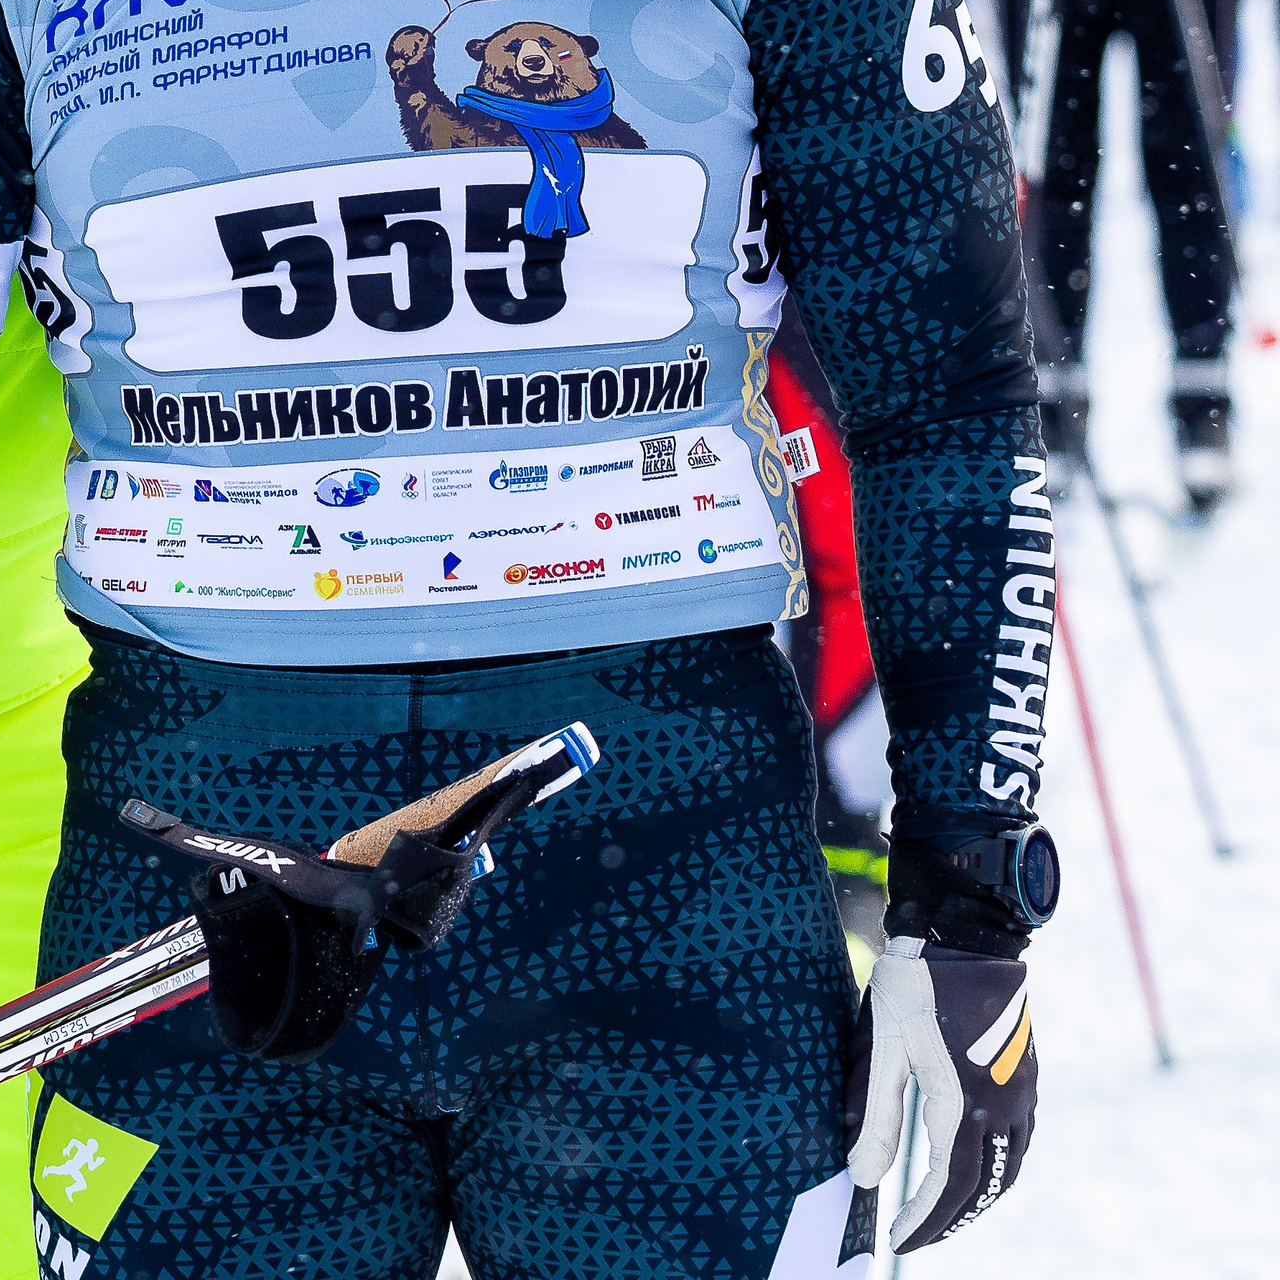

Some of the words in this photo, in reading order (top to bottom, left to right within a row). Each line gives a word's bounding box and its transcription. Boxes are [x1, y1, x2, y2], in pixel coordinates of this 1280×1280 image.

[152, 25, 289, 66] МАРАФОН
[99, 80, 142, 106] И.П.
[152, 41, 372, 90] ФАРХУТДИНОВА
[214, 182, 569, 340] 555
[122, 379, 431, 445] Мельников
[445, 346, 708, 428] Анатолий
[578, 459, 634, 477] ГАЗПРОМБАНК
[645, 458, 673, 473] ИКРА
[687, 453, 721, 467] ОМЕГА
[509, 465, 548, 478] ГАЗПРОМ
[263, 489, 299, 498] ВИДОВ
[615, 504, 681, 525] YAMAGUCHI
[370, 533, 455, 546] ИнфоЭксперт
[468, 524, 547, 540] АЭРОФЛОТ
[157, 539, 187, 548] ИТУРУП
[717, 538, 763, 554] ГИДРОСТРОЙ
[621, 550, 682, 570] INVITRO
[528, 557, 605, 580] ЭКОНОМ
[101, 578, 147, 593] GEL4U
[346, 570, 404, 585] ПЕРВЫЙ
[346, 584, 405, 597] СЕМЕЙНЫЙ
[428, 583, 478, 594] Ростелеком
[979, 455, 1057, 822] SAKHALIN
